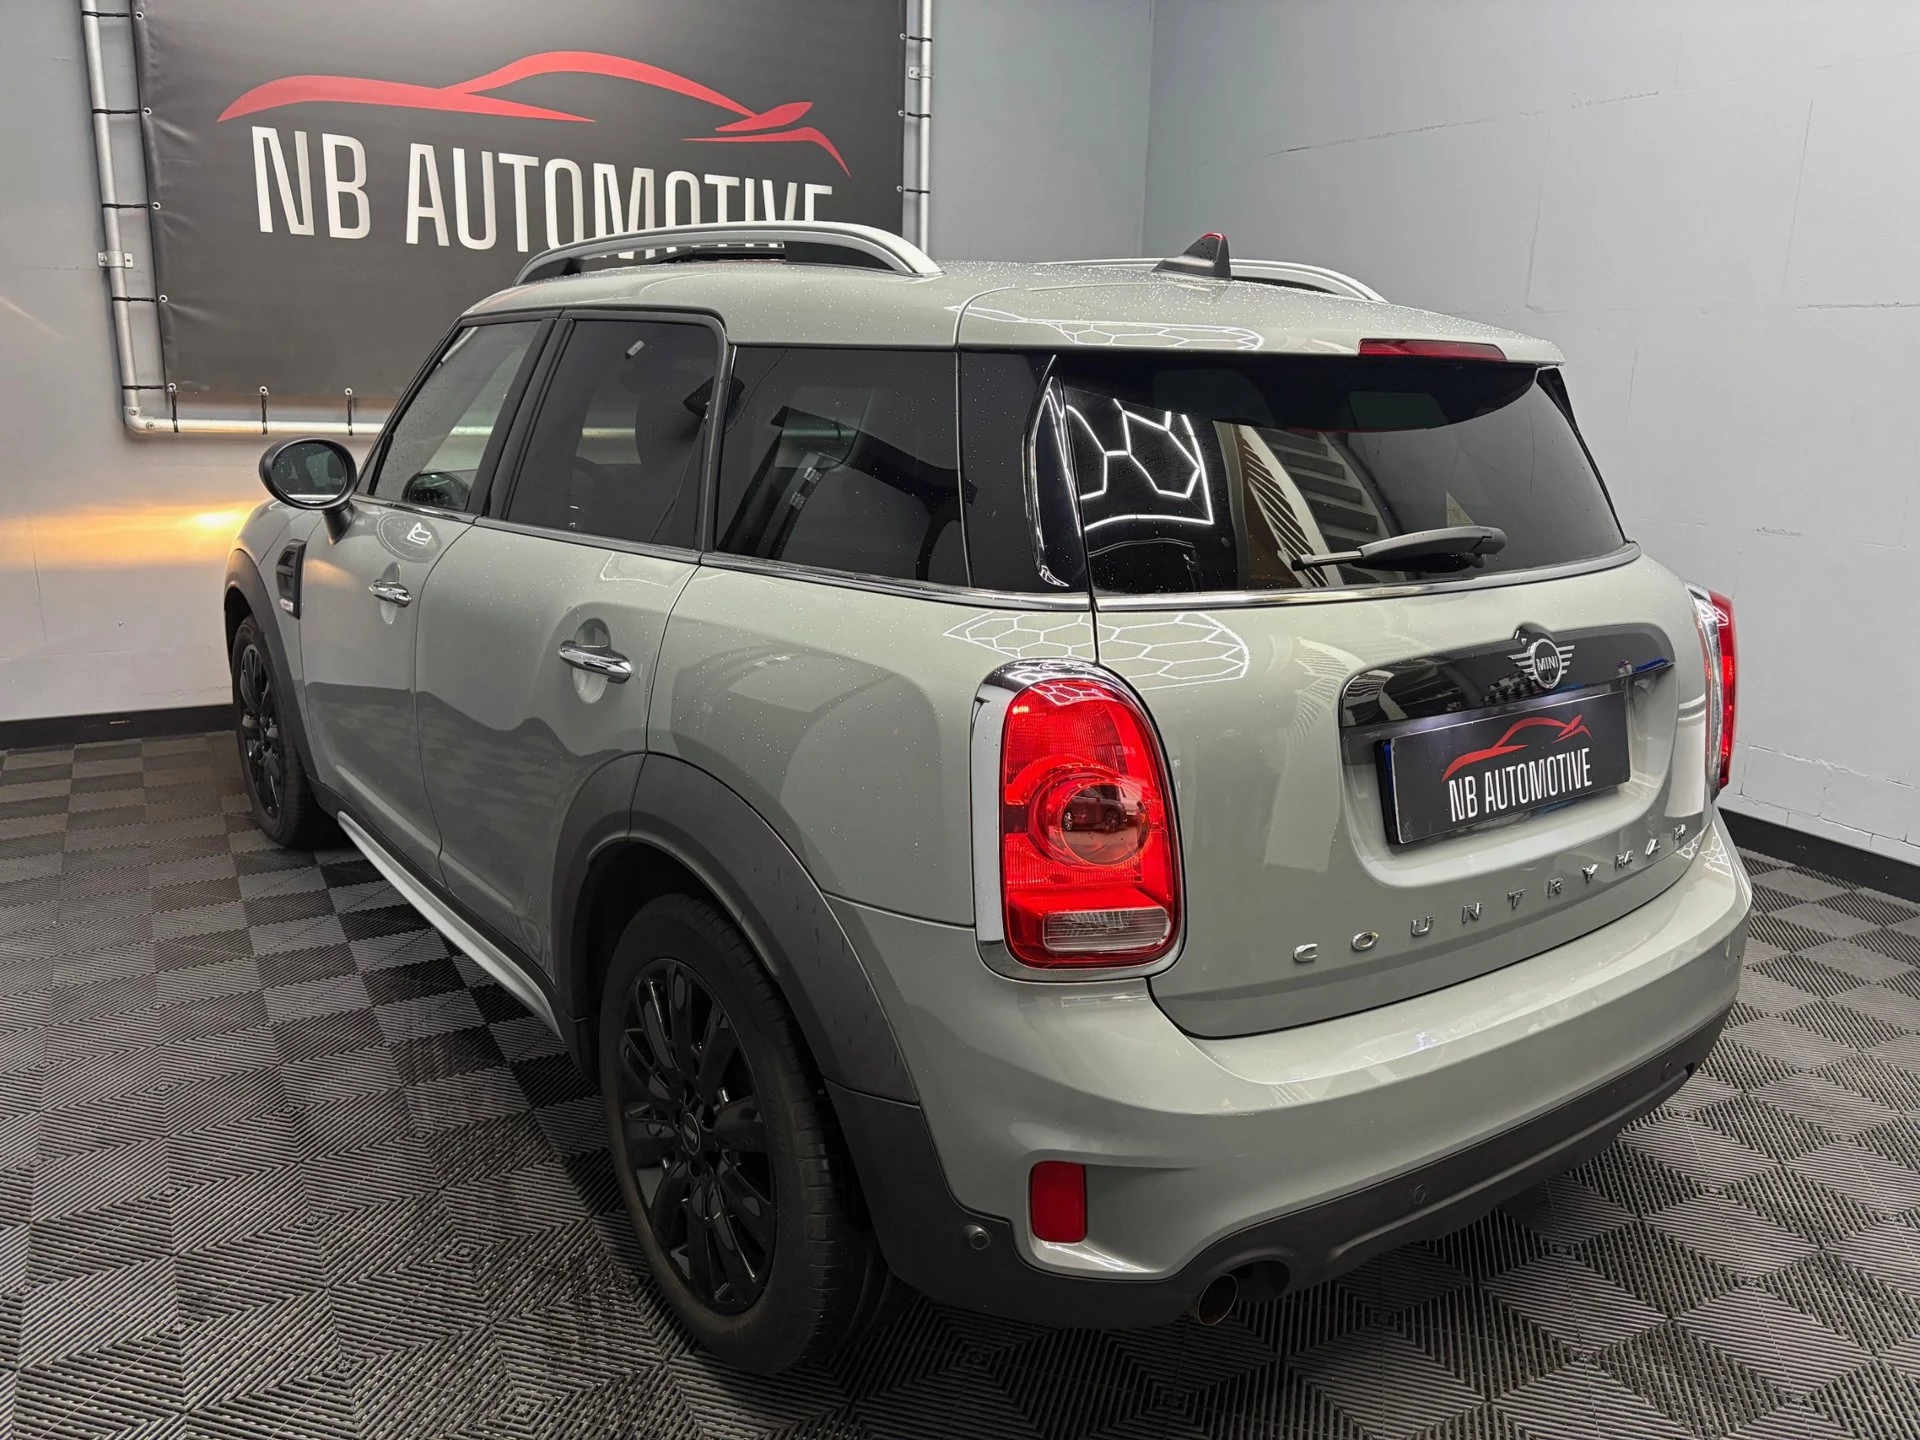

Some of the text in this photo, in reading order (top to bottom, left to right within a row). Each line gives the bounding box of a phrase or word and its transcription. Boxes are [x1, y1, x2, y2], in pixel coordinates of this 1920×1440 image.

[252, 126, 371, 240] NB
[1536, 655, 1559, 671] MINI
[1449, 748, 1592, 822] NB AUTOMOTIVE
[1293, 824, 1686, 963] COUNTRYMAN
